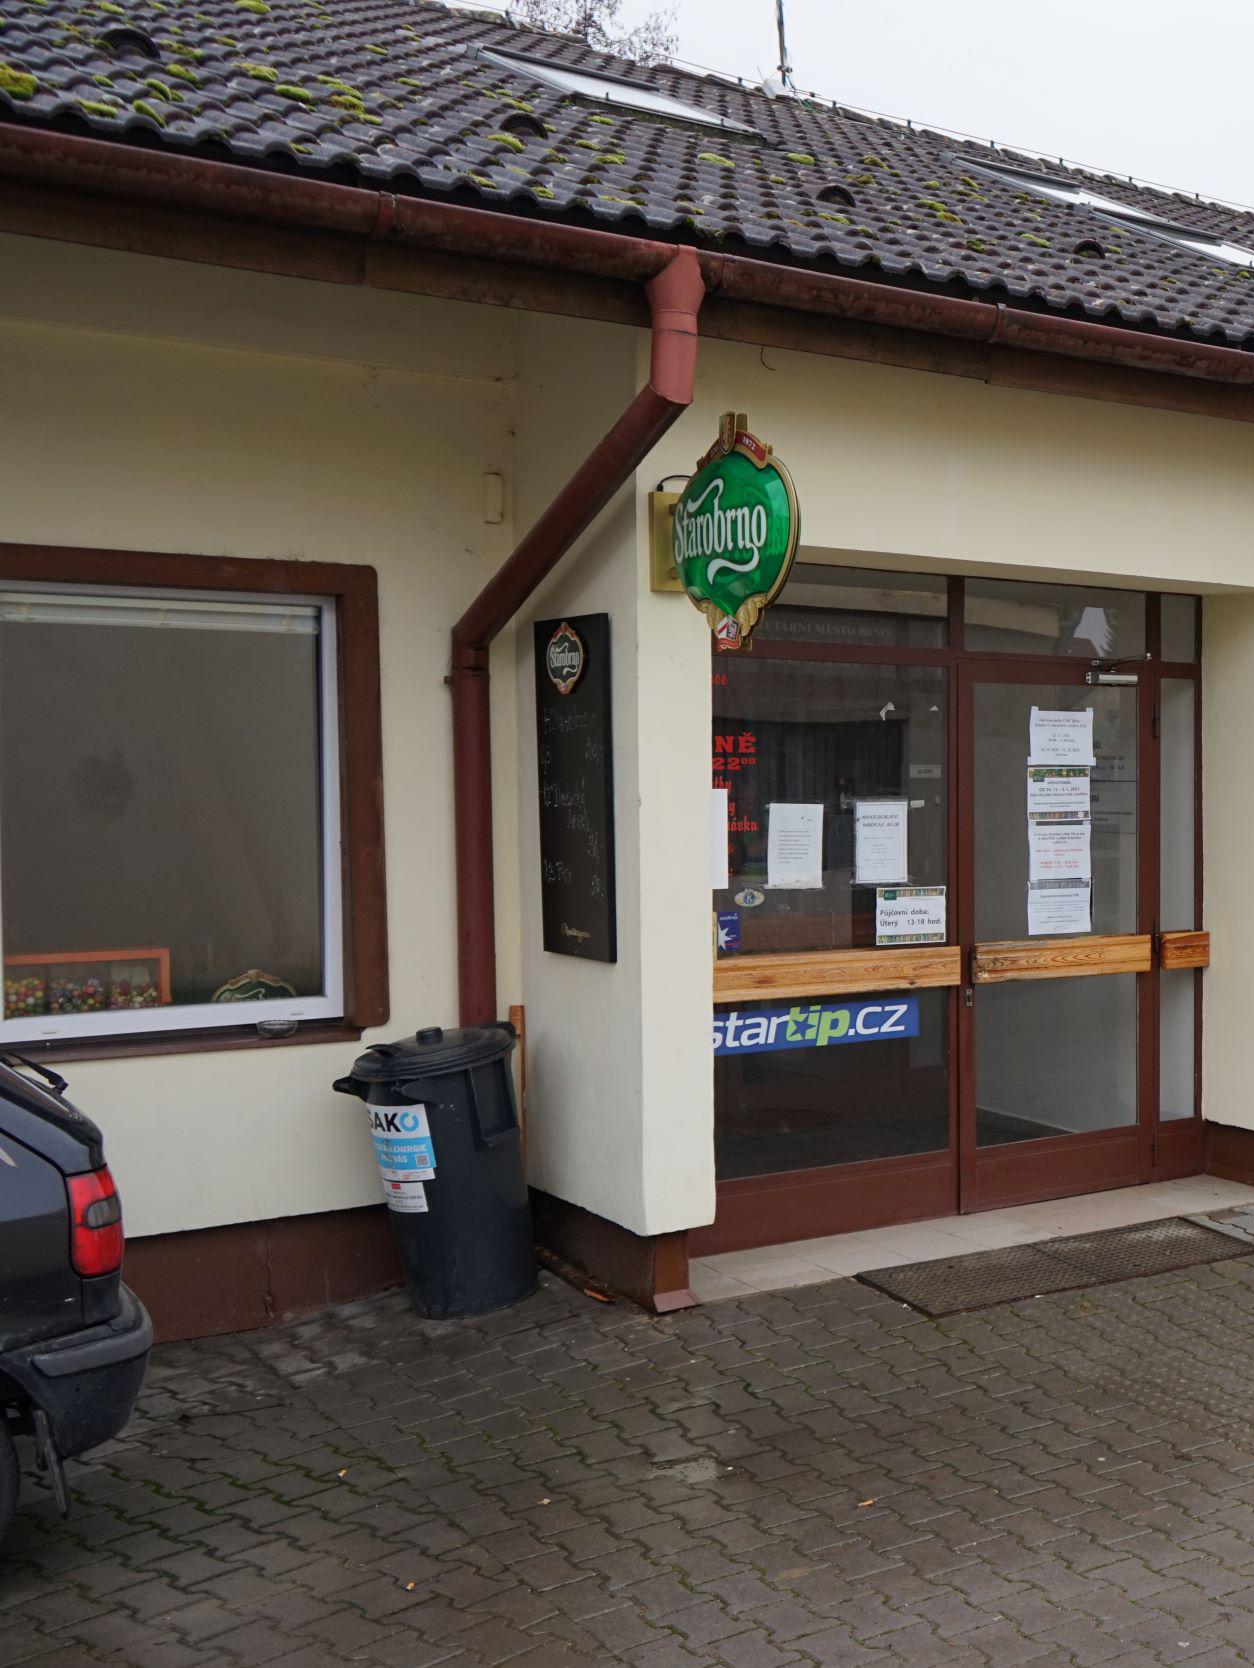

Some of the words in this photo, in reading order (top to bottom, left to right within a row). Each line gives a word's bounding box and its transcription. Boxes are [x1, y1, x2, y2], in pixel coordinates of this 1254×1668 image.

[675, 478, 767, 585] Starobrno
[714, 731, 757, 753] NĚ
[880, 908, 908, 918] Půjčovní
[880, 919, 898, 928] Úterý
[907, 918, 925, 926] 13-18
[927, 917, 942, 925] hod.
